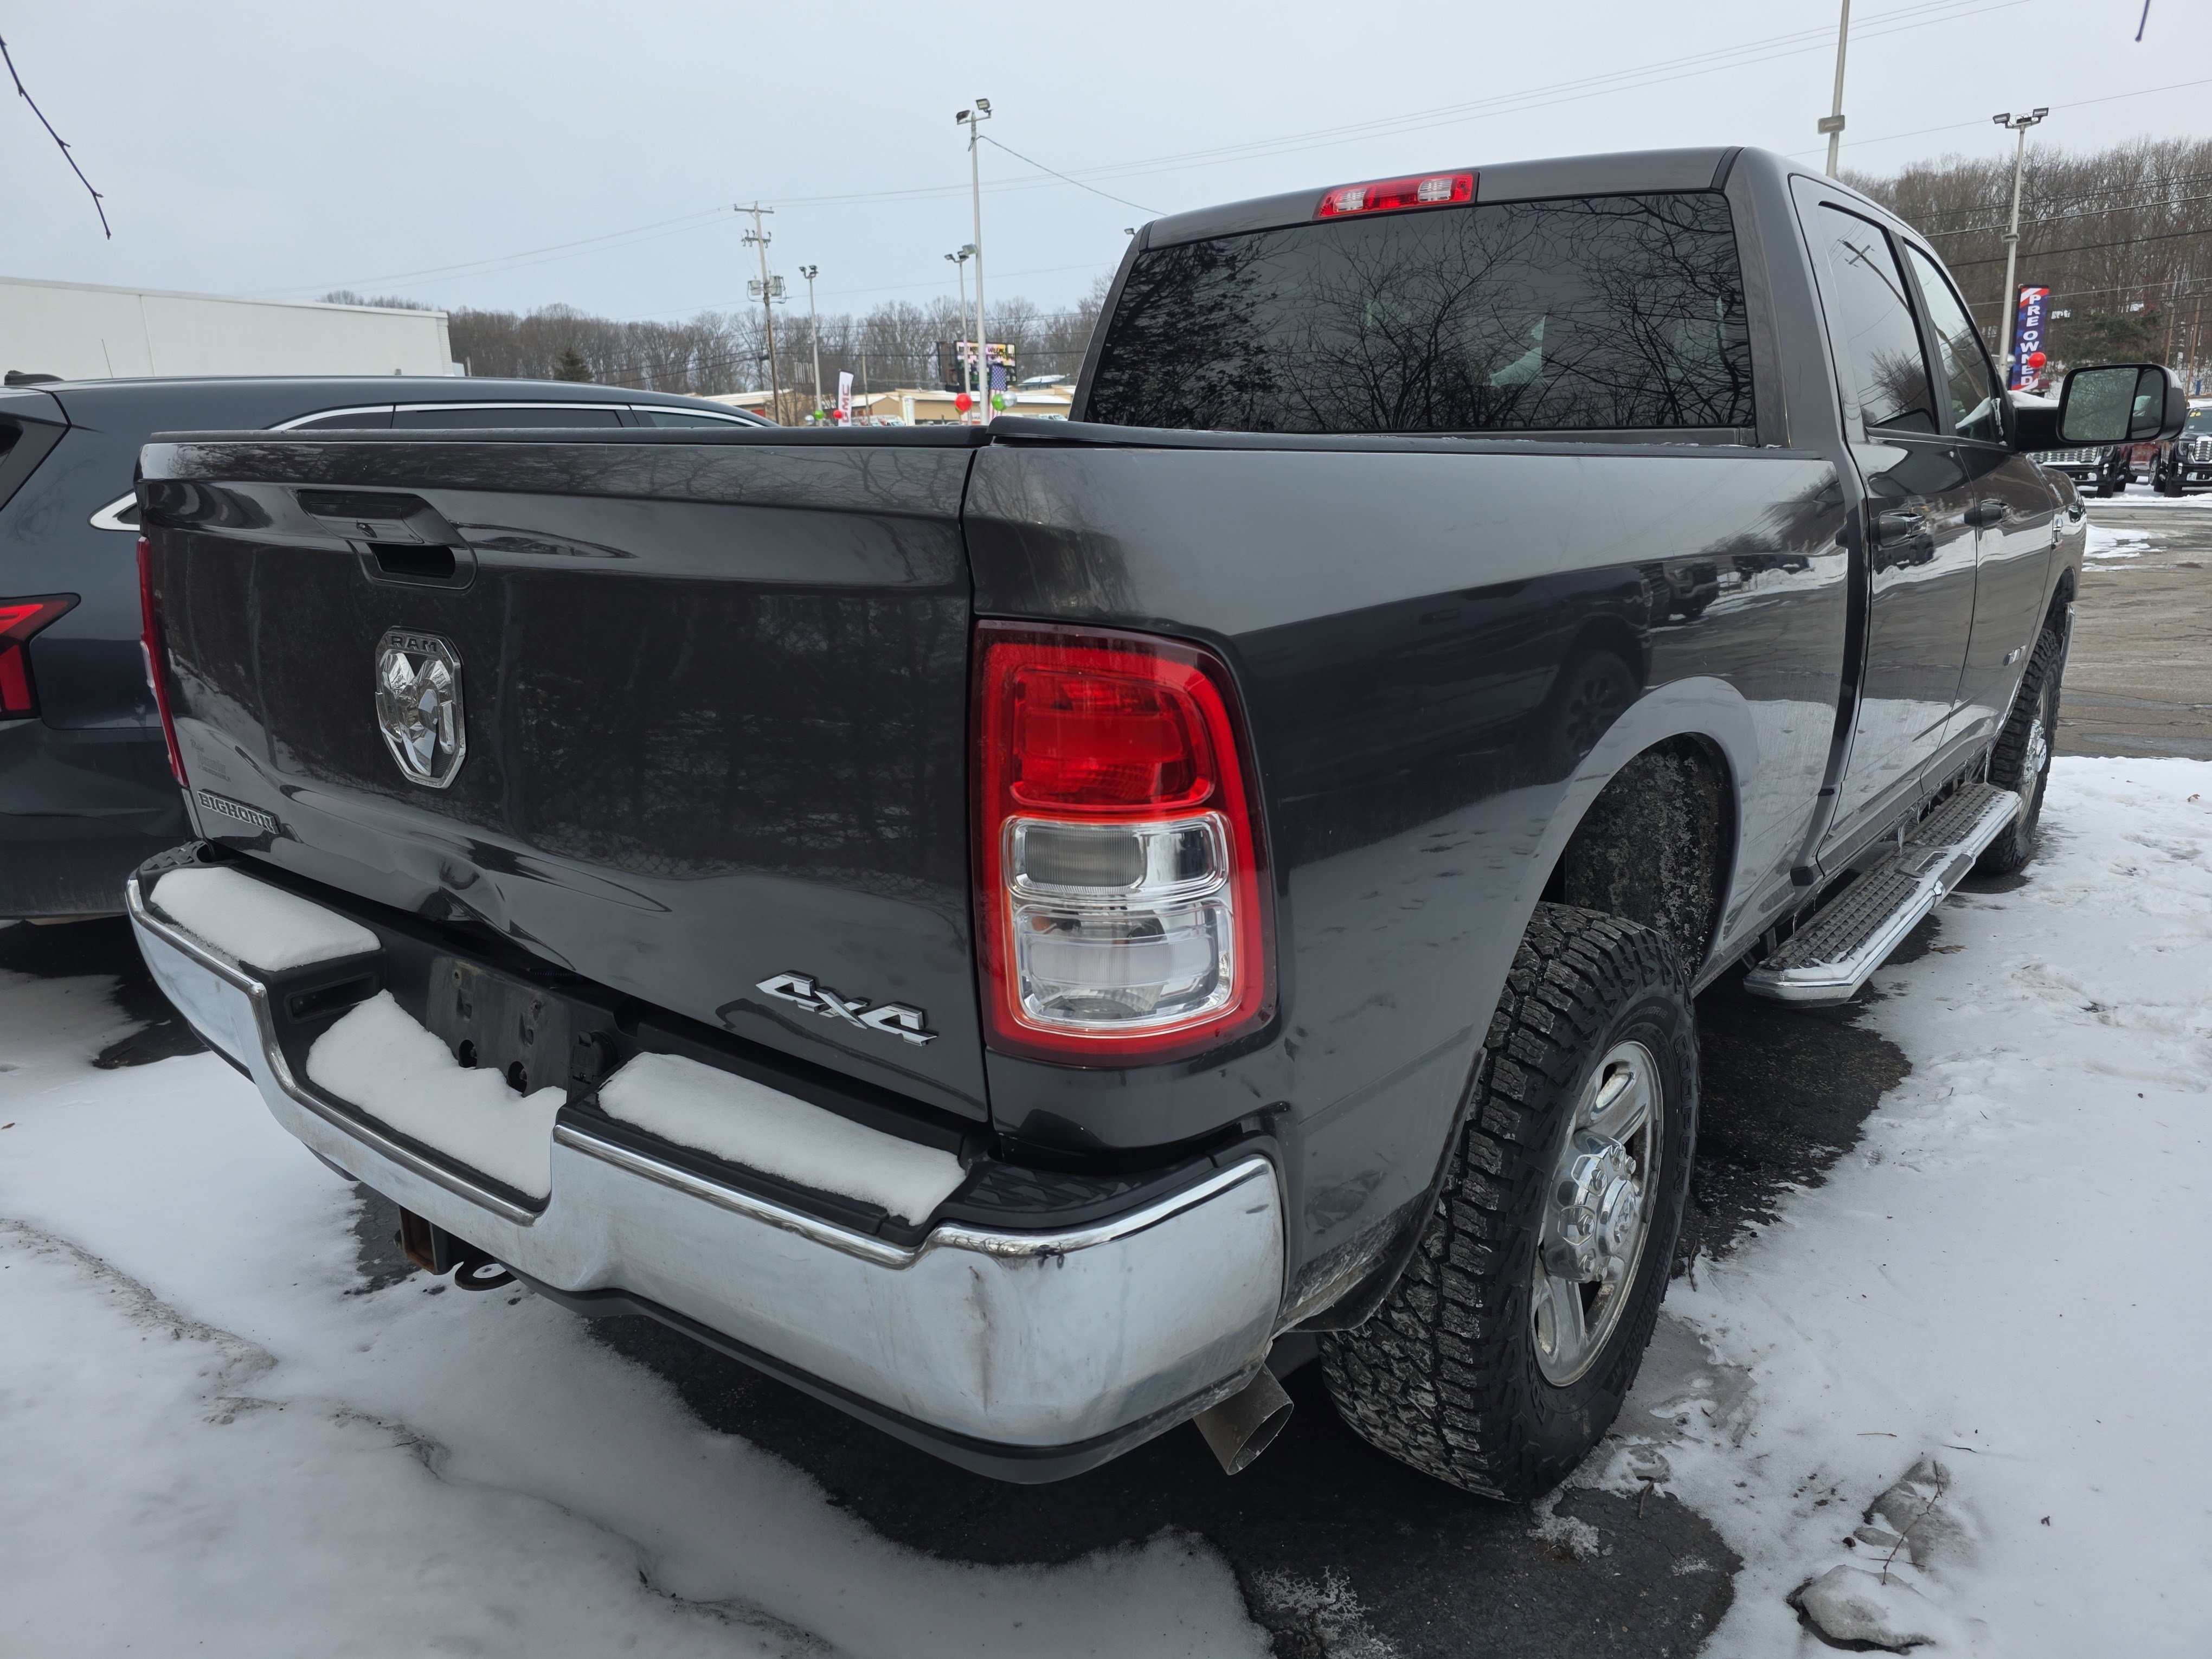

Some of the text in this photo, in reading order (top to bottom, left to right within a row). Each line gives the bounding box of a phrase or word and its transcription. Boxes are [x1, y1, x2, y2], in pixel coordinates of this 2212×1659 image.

[2020, 294, 2041, 385] PRE OWNED
[841, 383, 850, 423] GMC
[390, 634, 438, 652] RAM
[1674, 1034, 1692, 1192] COOPER
[1625, 1221, 1671, 1357] STRONGHOLD
